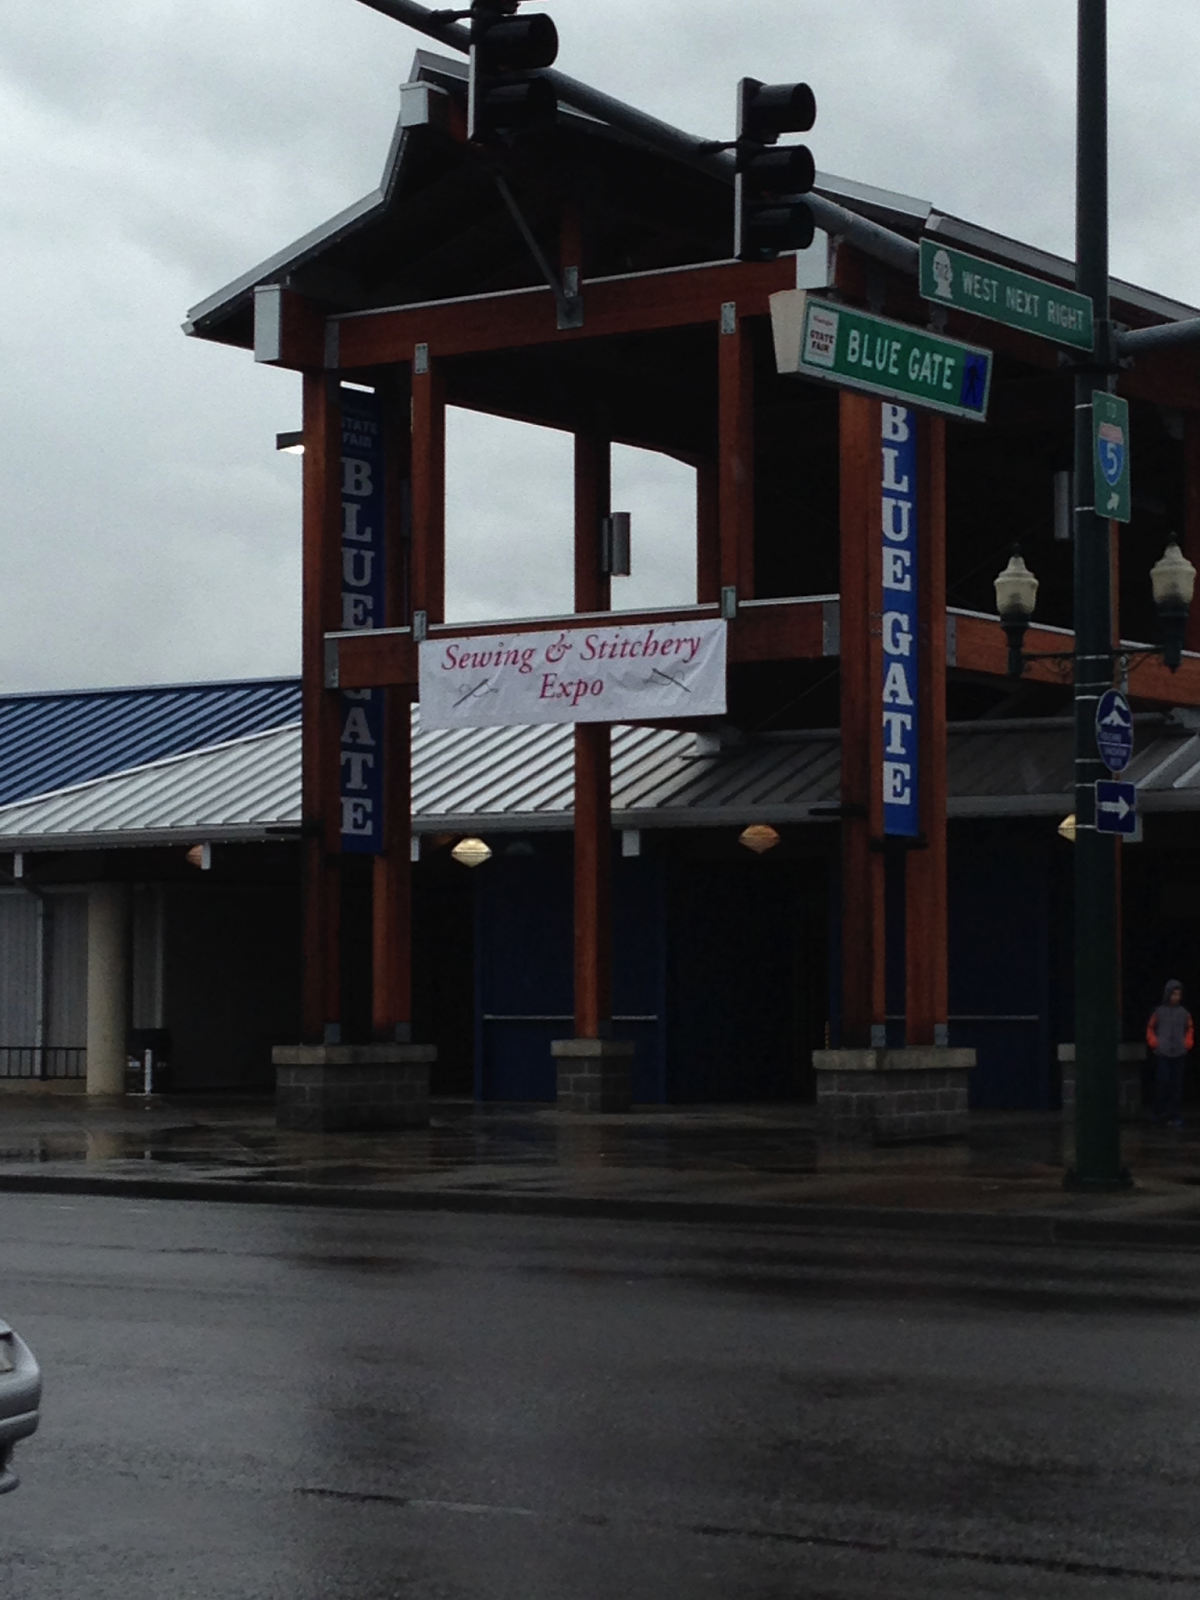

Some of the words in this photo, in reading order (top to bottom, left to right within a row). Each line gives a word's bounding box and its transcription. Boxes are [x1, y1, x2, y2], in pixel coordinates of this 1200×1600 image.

[961, 270, 999, 303] WEST
[1005, 285, 1040, 318] NEXT
[1047, 300, 1084, 332] RIGHT
[846, 330, 901, 375] BLUE
[908, 347, 956, 391] GATE
[1107, 442, 1118, 476] 5
[881, 401, 912, 593] BLUE
[341, 456, 375, 629] BLUE
[441, 642, 537, 674] Sewing
[545, 633, 573, 664] &
[580, 629, 702, 664] Stitchery
[539, 673, 605, 707] Expo
[881, 611, 914, 805] GATE
[341, 688, 376, 836] ATE
